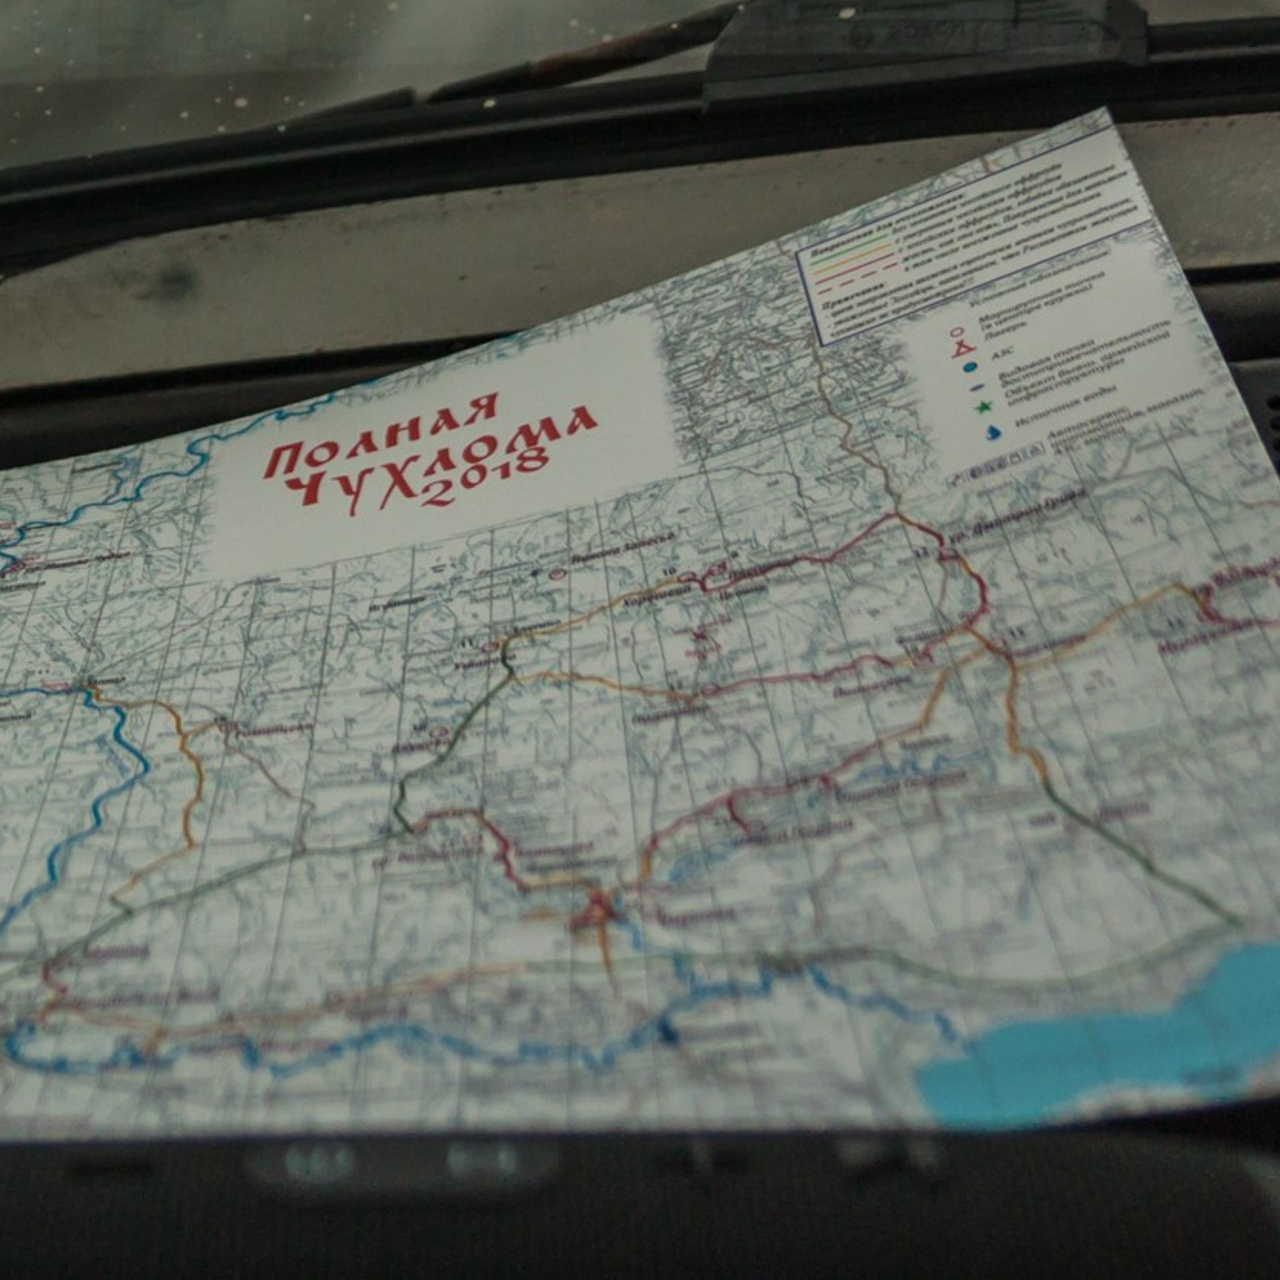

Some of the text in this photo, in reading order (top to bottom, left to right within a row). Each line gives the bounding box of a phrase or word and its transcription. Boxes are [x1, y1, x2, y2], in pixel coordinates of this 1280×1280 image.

[263, 391, 499, 480] ПОЛНАЯ
[285, 405, 599, 516] ЧУХЛОМА
[420, 446, 550, 508] 2018
